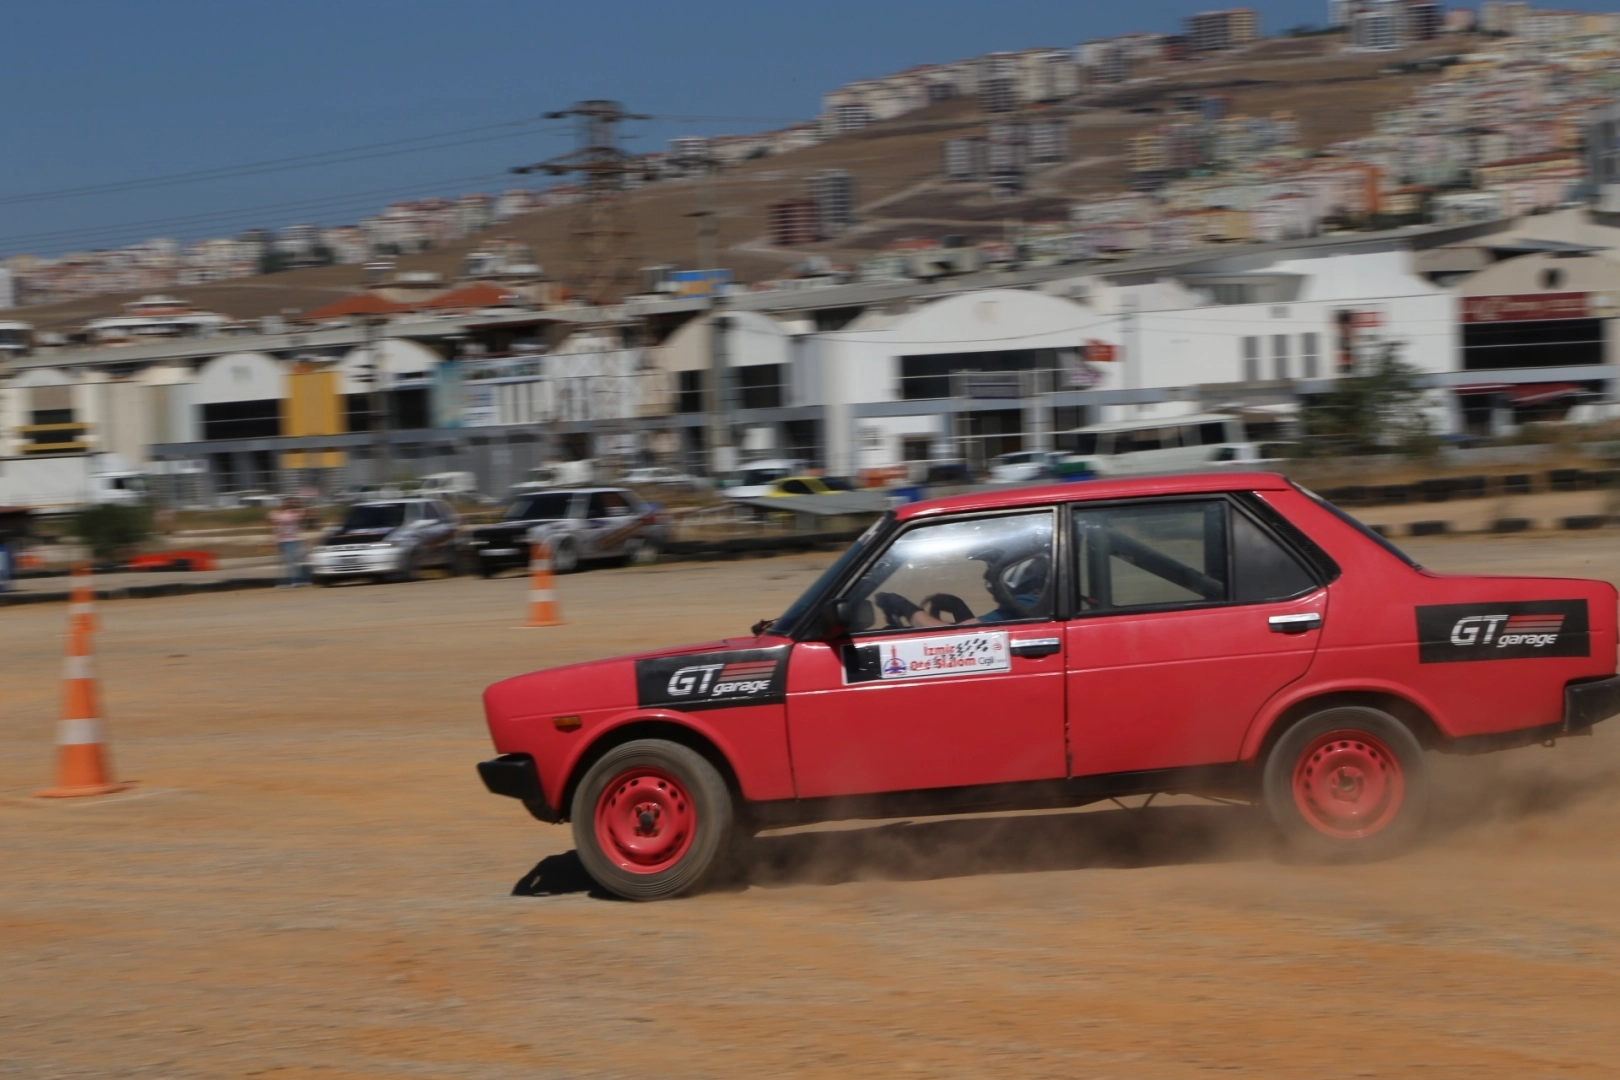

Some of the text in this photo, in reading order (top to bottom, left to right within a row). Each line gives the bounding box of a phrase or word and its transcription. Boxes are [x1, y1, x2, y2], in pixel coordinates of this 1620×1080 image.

[1450, 614, 1509, 646] GT
[1496, 633, 1558, 648] garage
[934, 656, 977, 669] Slalom
[667, 663, 725, 696] GT
[711, 680, 771, 697] garage
